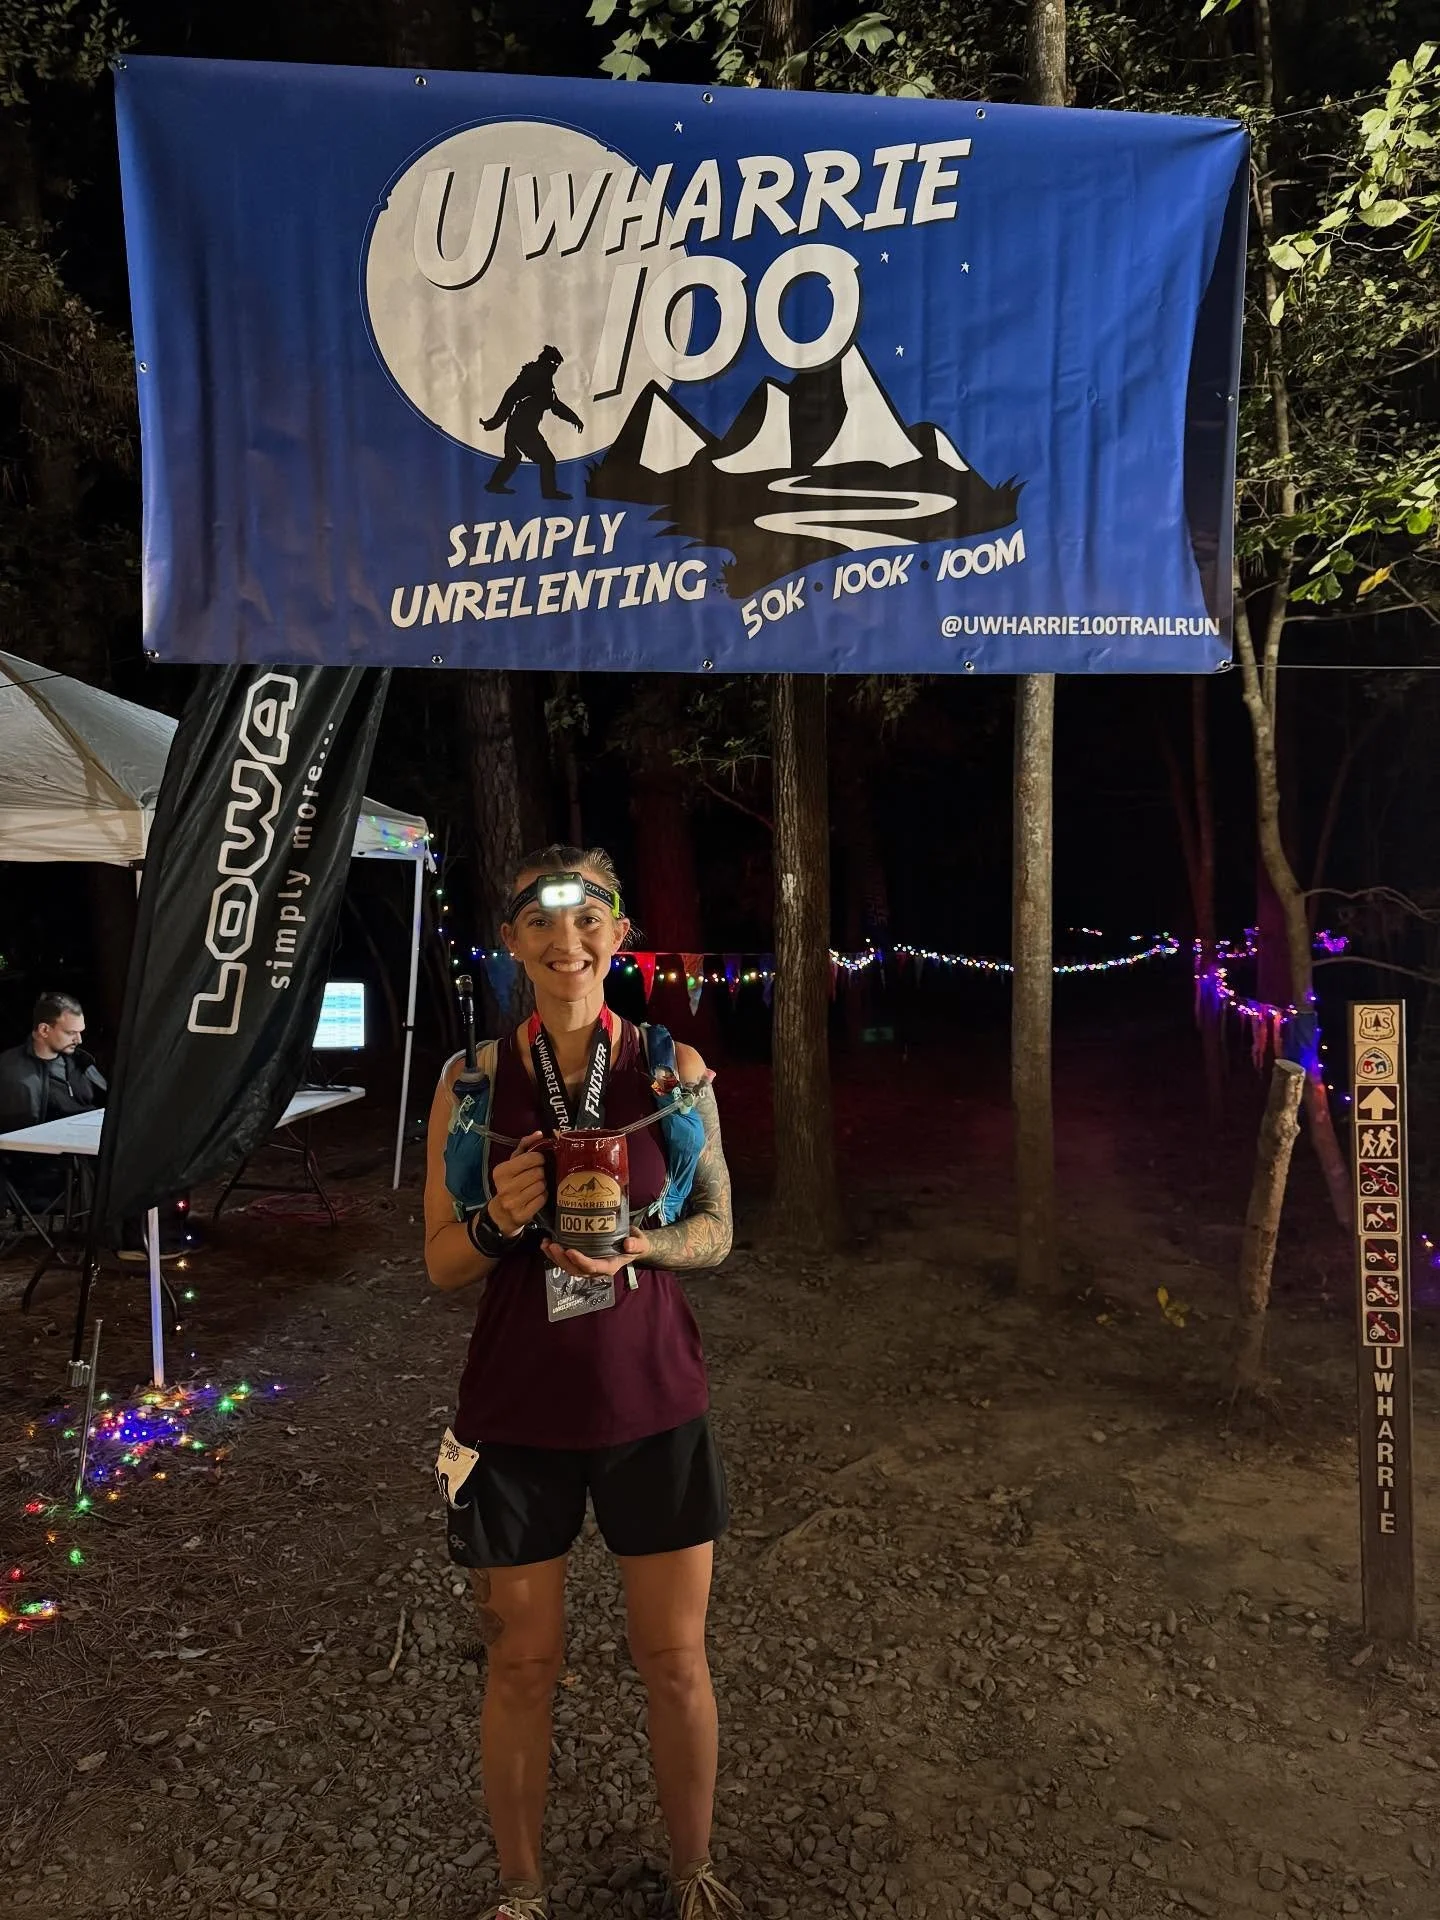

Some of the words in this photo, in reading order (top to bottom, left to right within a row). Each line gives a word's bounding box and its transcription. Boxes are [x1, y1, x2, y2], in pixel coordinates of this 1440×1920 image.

[413, 138, 972, 290] UWHARRIE
[593, 243, 861, 402] 100
[447, 511, 627, 568] SIMPLY
[389, 559, 708, 629] UNRELENTING
[740, 576, 806, 640] 50K
[832, 554, 914, 600] 100K
[936, 528, 1026, 583] 100M
[940, 615, 1220, 638] @UWHARRIE100TRAILRUN
[264, 869, 311, 990] simply
[583, 880, 609, 897] ORCY
[535, 1034, 560, 1094] UWHARRIE
[549, 1095, 572, 1133] ULTRA
[585, 1043, 607, 1118] FINISHER
[562, 1216, 581, 1231] 100
[1373, 1346, 1396, 1534] UWHARRIE
